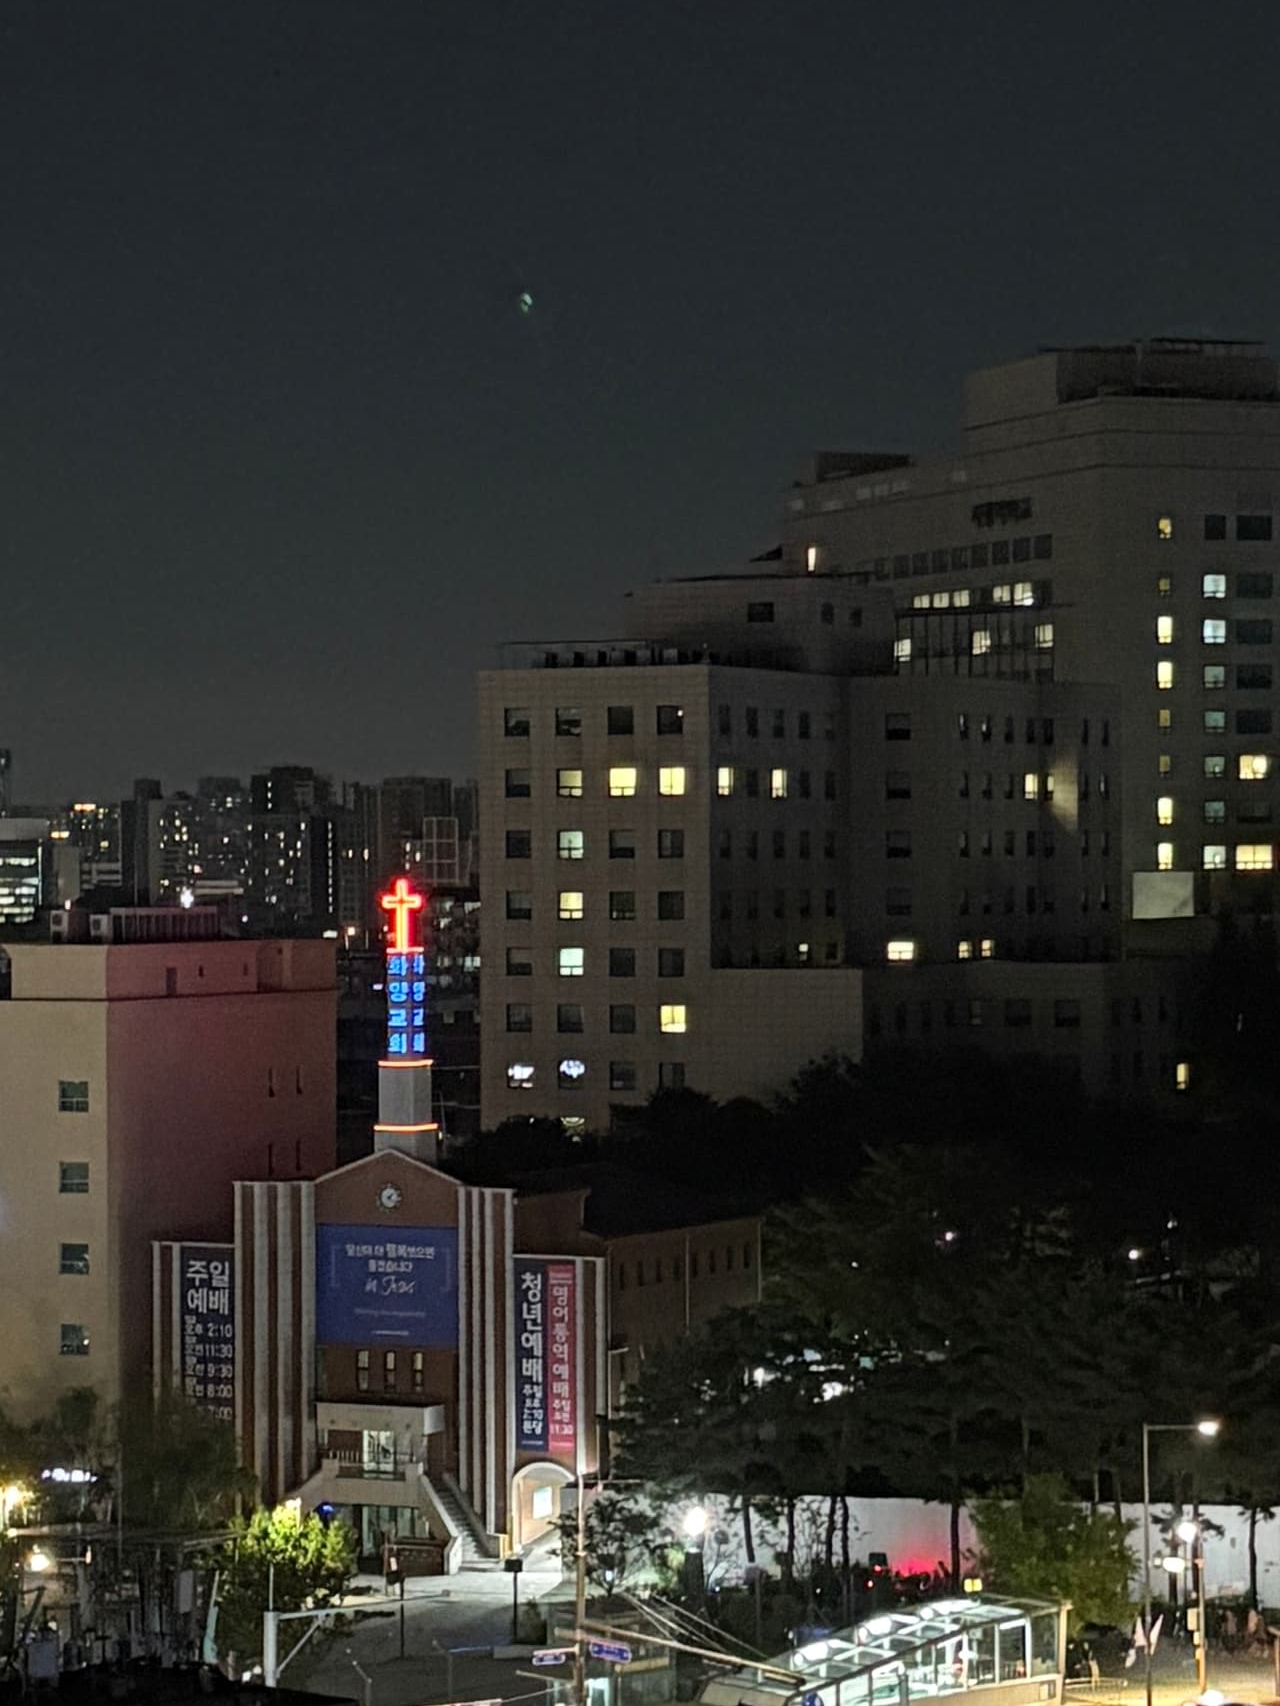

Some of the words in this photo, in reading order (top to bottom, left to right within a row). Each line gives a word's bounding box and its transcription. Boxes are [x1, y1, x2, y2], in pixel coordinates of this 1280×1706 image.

[386, 955, 409, 1054] 화양교회
[185, 1259, 230, 1288] 주일
[186, 1287, 230, 1316] 예배
[207, 1322, 233, 1337] 2:10
[521, 1271, 543, 1383] 청년예배
[205, 1343, 233, 1357] 11:30
[207, 1363, 233, 1378] 9:30
[207, 1383, 233, 1398] 8:00
